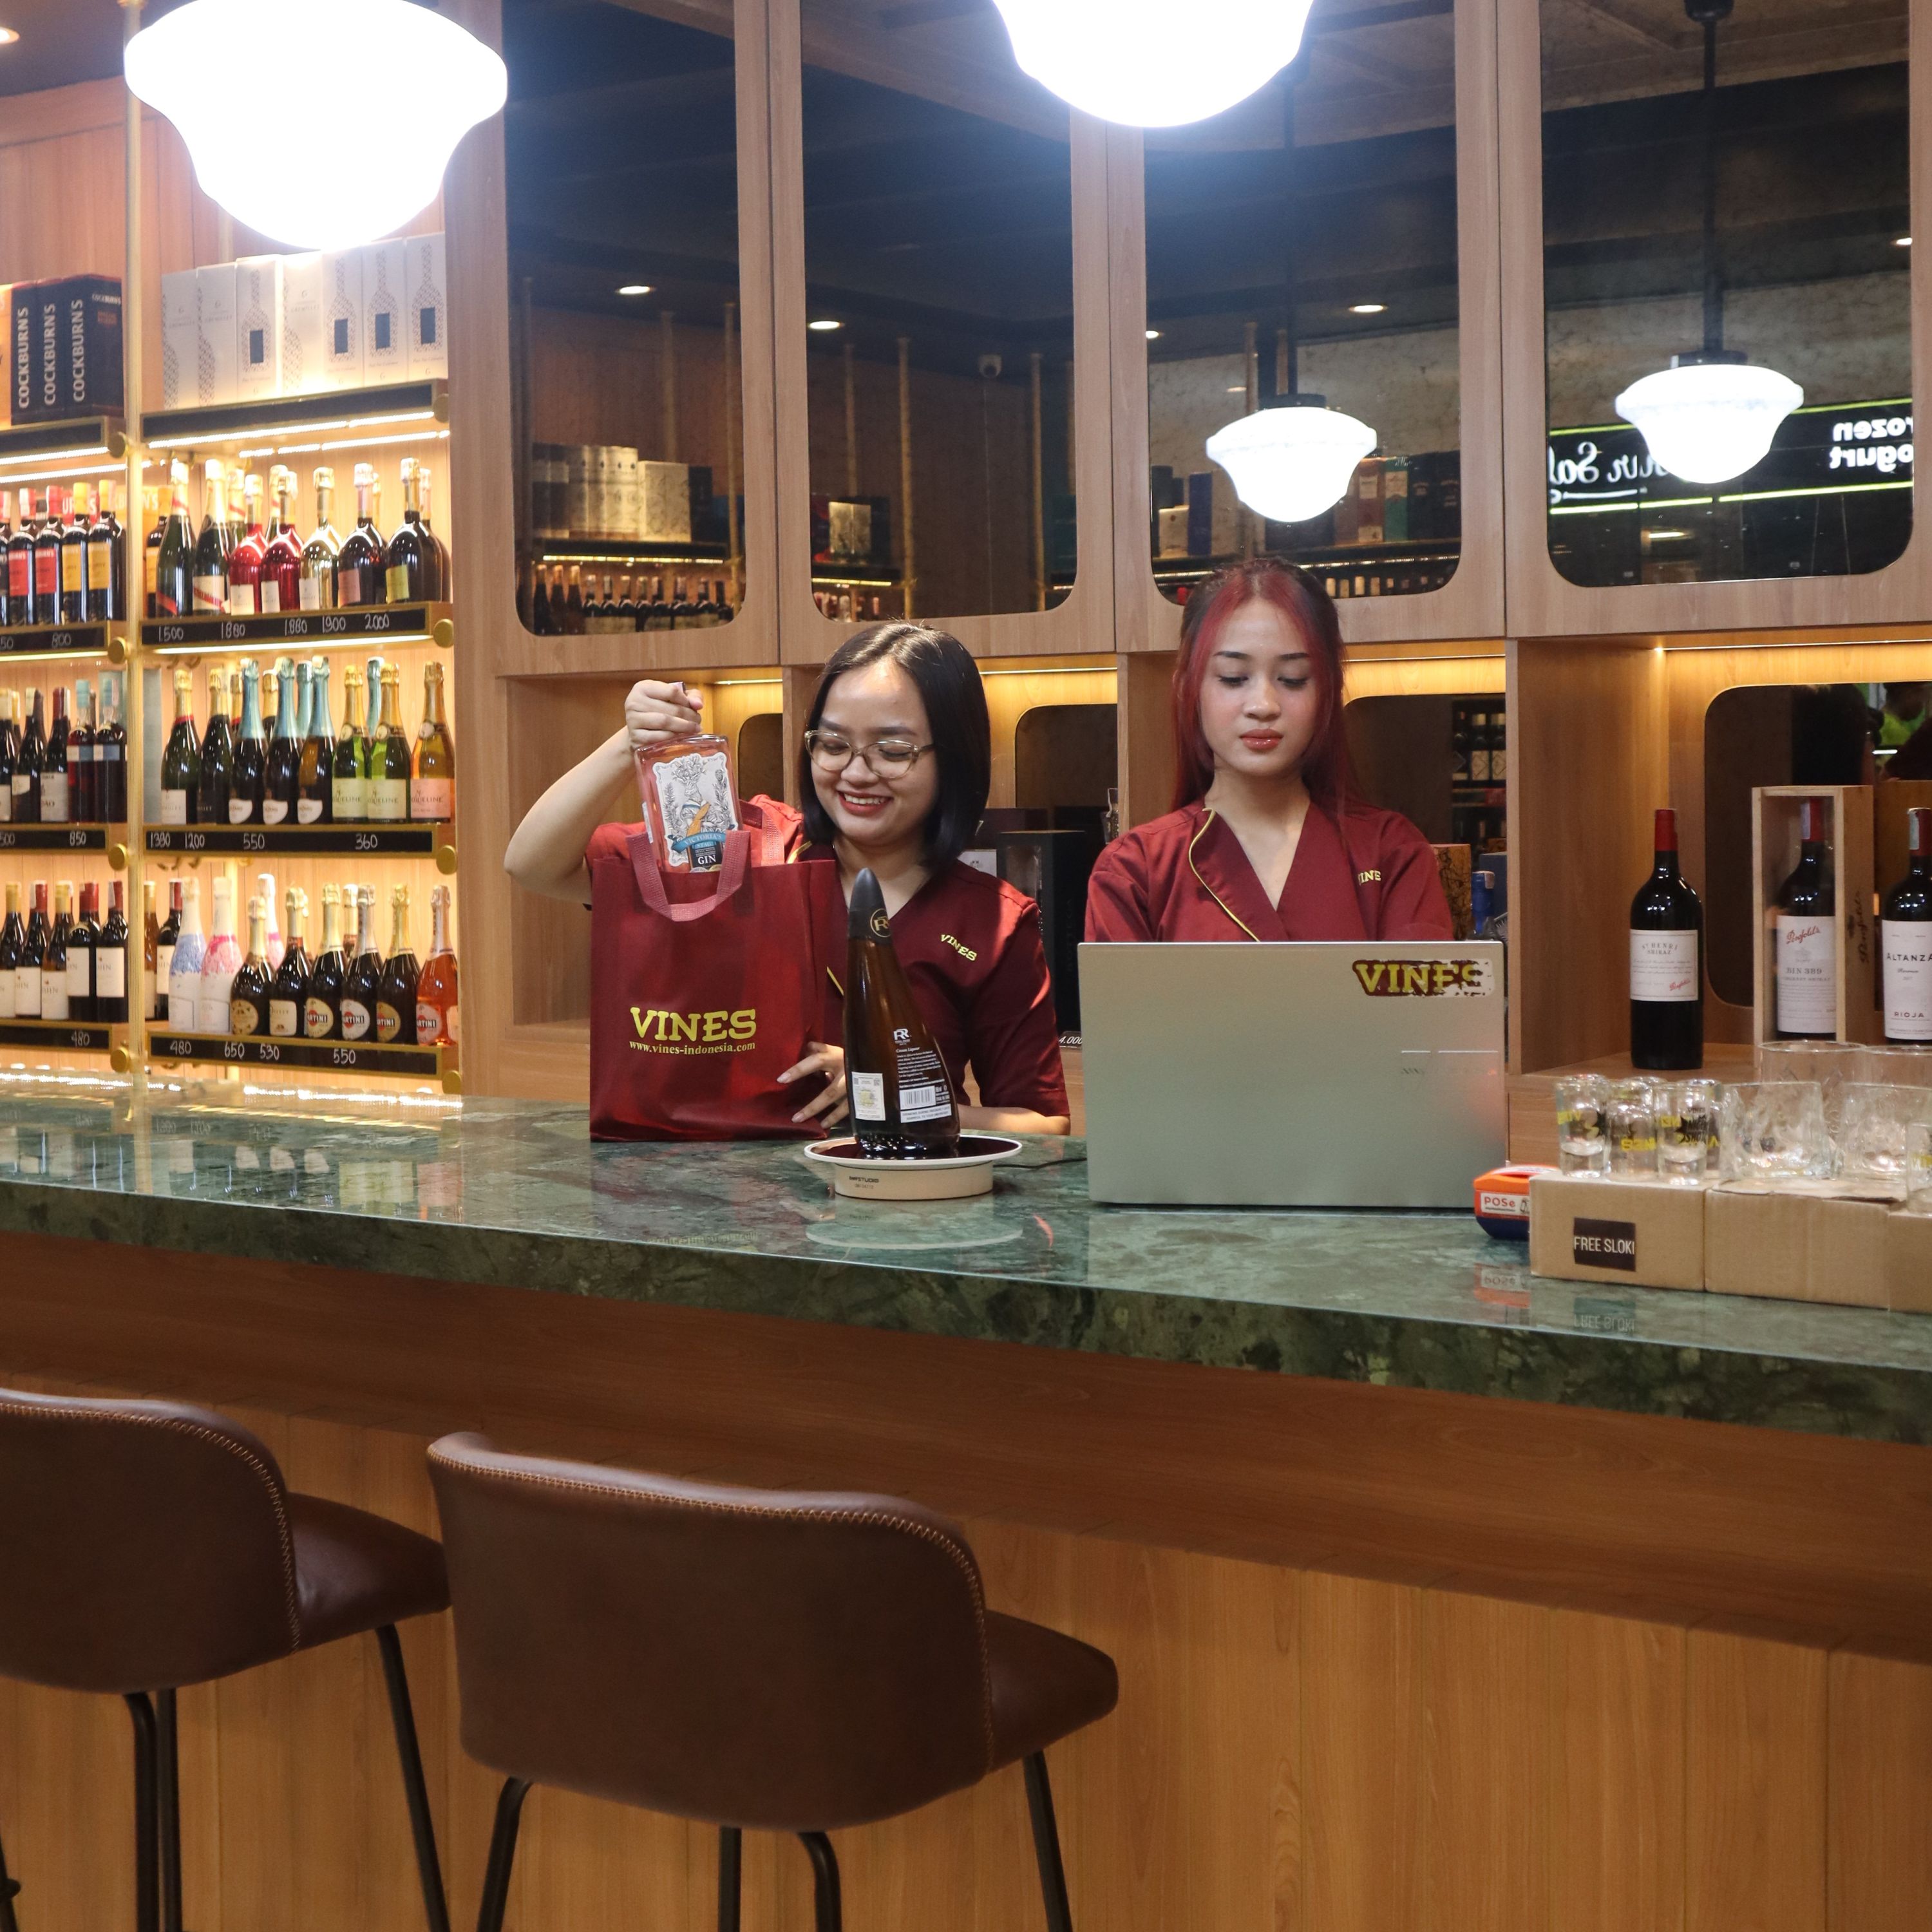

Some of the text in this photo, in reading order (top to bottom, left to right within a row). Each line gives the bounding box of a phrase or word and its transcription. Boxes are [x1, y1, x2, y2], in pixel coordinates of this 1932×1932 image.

[18, 307, 30, 408] COCKBURNS
[44, 303, 56, 405] COCKBURNS
[71, 299, 85, 402] COCKBURNS
[52, 633, 71, 649] 800
[70, 831, 87, 846] 850
[243, 833, 265, 850] 550
[355, 834, 378, 850] 360
[684, 833, 722, 844] VICTORIA'S
[697, 855, 717, 865] GIN
[1358, 869, 1381, 886] INE
[1786, 925, 1821, 944] Penfolds
[941, 934, 978, 961] VINES
[630, 1007, 757, 1042] VINES
[71, 1030, 91, 1046] 480
[170, 1040, 356, 1065] 480 650 530 550
[629, 1040, 755, 1055] www.vines-indonesia.com
[1484, 1197, 1515, 1208] POSe
[1574, 1236, 1635, 1255] FREE SLOKI
